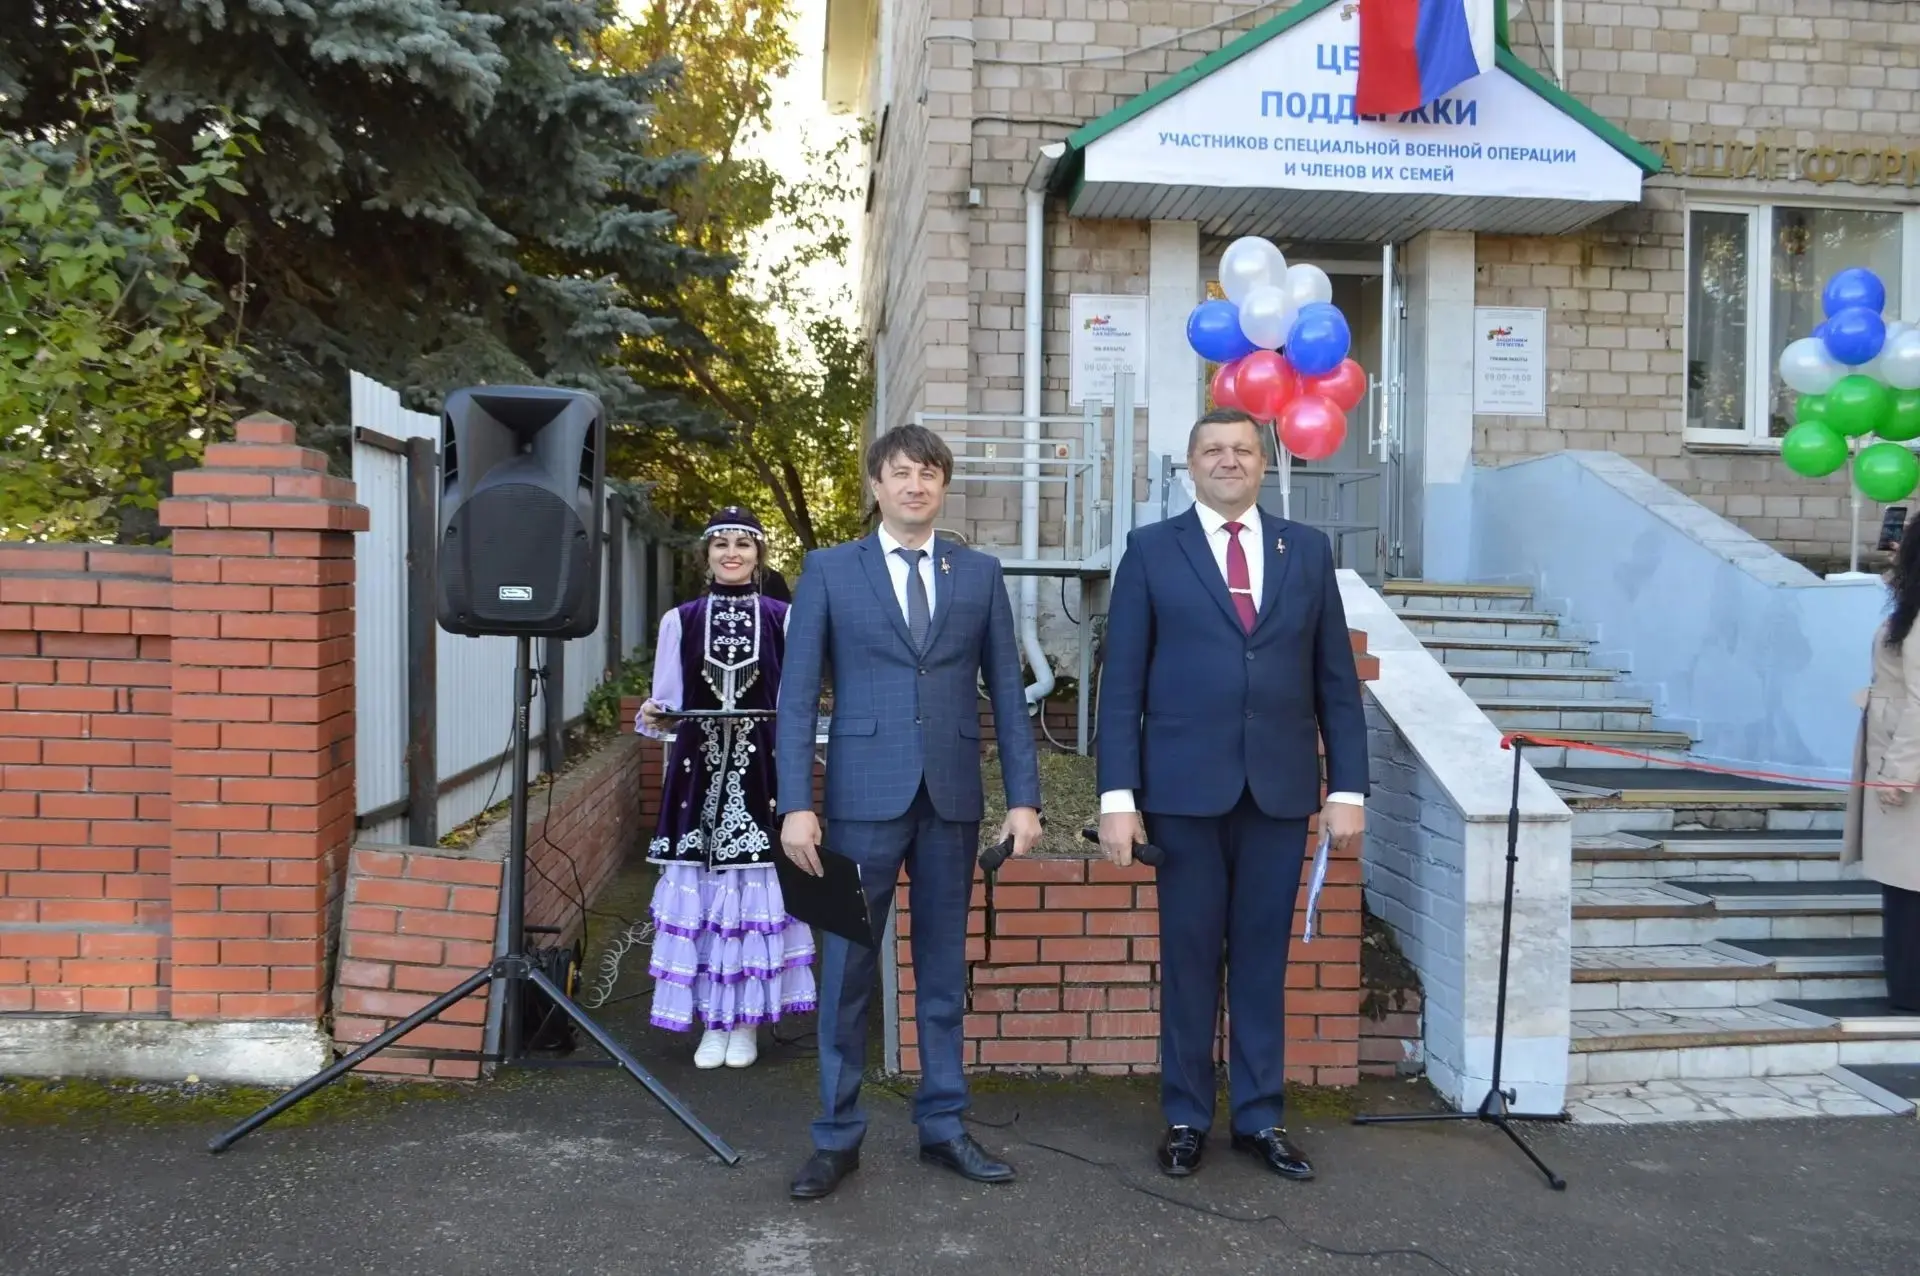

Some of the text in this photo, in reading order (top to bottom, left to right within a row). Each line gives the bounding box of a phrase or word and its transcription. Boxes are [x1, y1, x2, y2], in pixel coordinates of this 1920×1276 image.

[1261, 91, 1477, 126] ПОДДЖКИ
[1158, 132, 1576, 164] УЧАСТНИКОВ СПЕЦИАЛЬНОЙ ВОЕННОЙ ОПЕРАЦИИ
[1285, 162, 1454, 182] И ЧЛЕНОВ ИХ СЕМЕЙ
